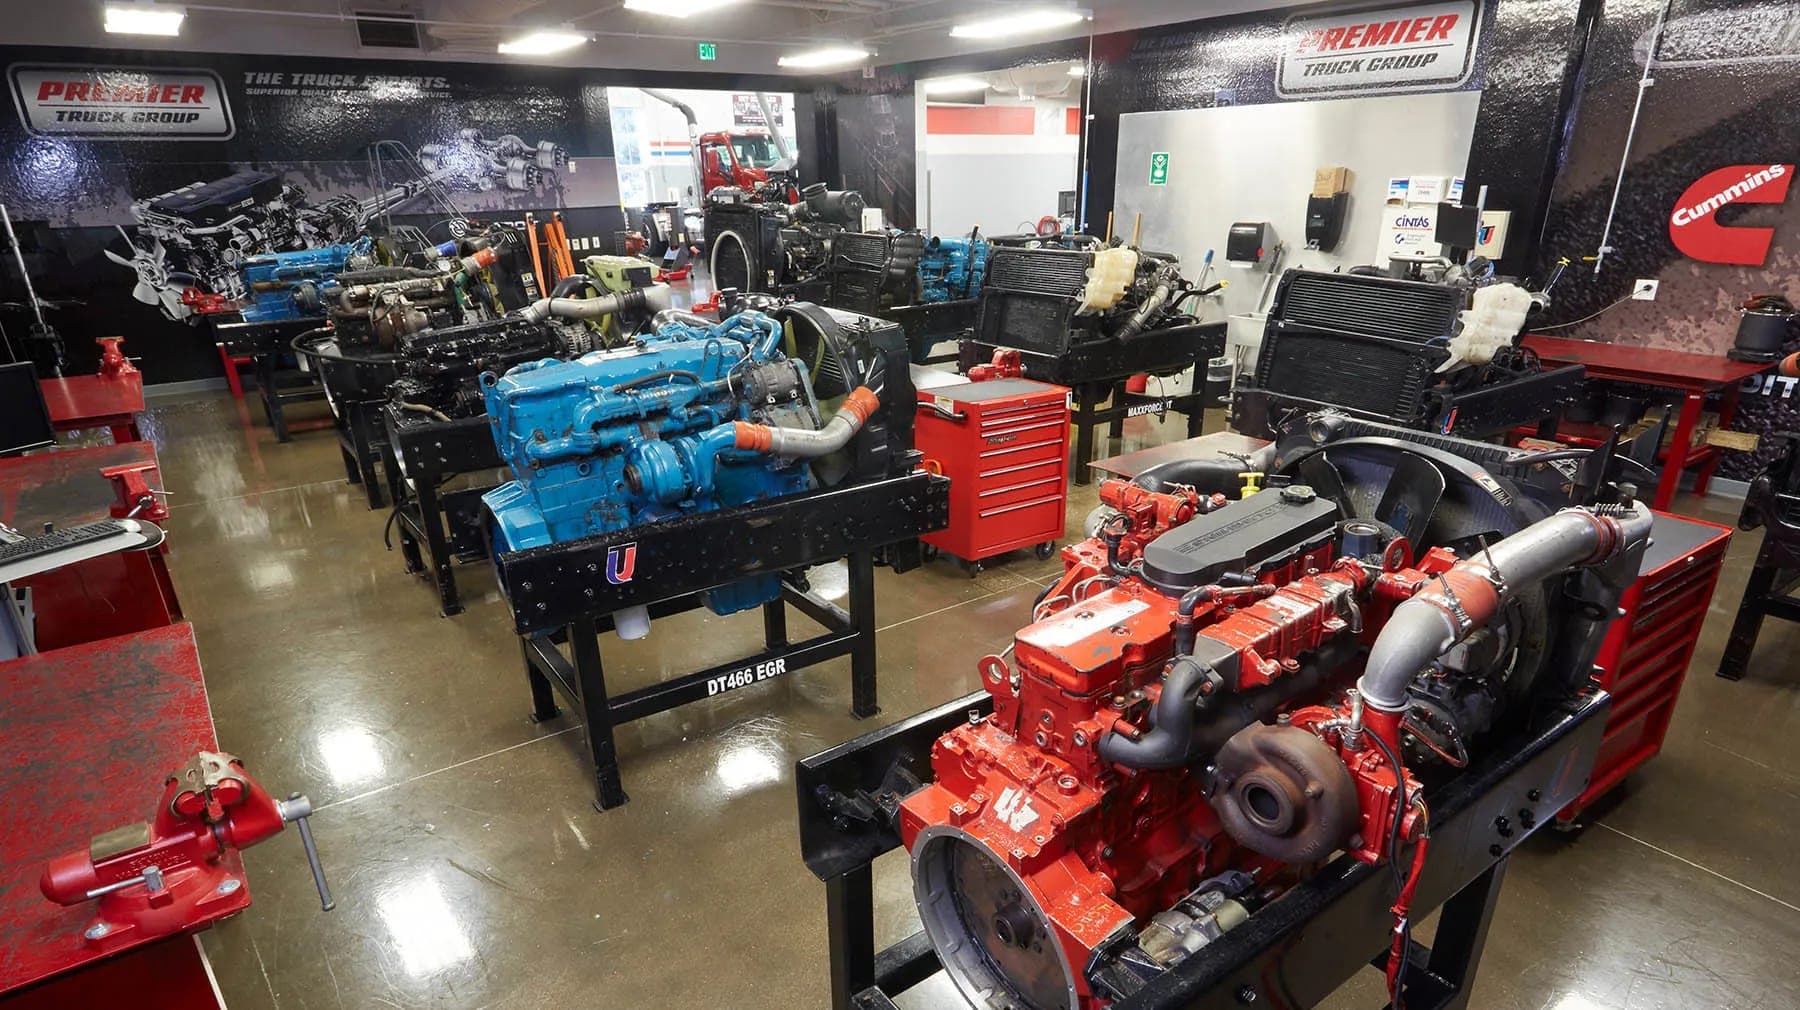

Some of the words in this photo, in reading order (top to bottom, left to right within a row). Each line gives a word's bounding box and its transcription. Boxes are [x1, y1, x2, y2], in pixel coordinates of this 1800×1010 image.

[1297, 14, 1459, 53] PREMIER
[699, 43, 716, 60] EXIT
[1303, 59, 1366, 77] TRUCK
[1367, 53, 1439, 72] GROUP
[244, 71, 284, 85] THE
[291, 73, 356, 87] TRUCK
[37, 80, 206, 104] PREMIER
[246, 87, 299, 96] SUPERIOR
[55, 110, 126, 123] TRUCK
[132, 111, 200, 123] GROUP
[1671, 163, 1786, 227] Cummins
[707, 668, 754, 696] DT466
[756, 658, 786, 681] EGR
